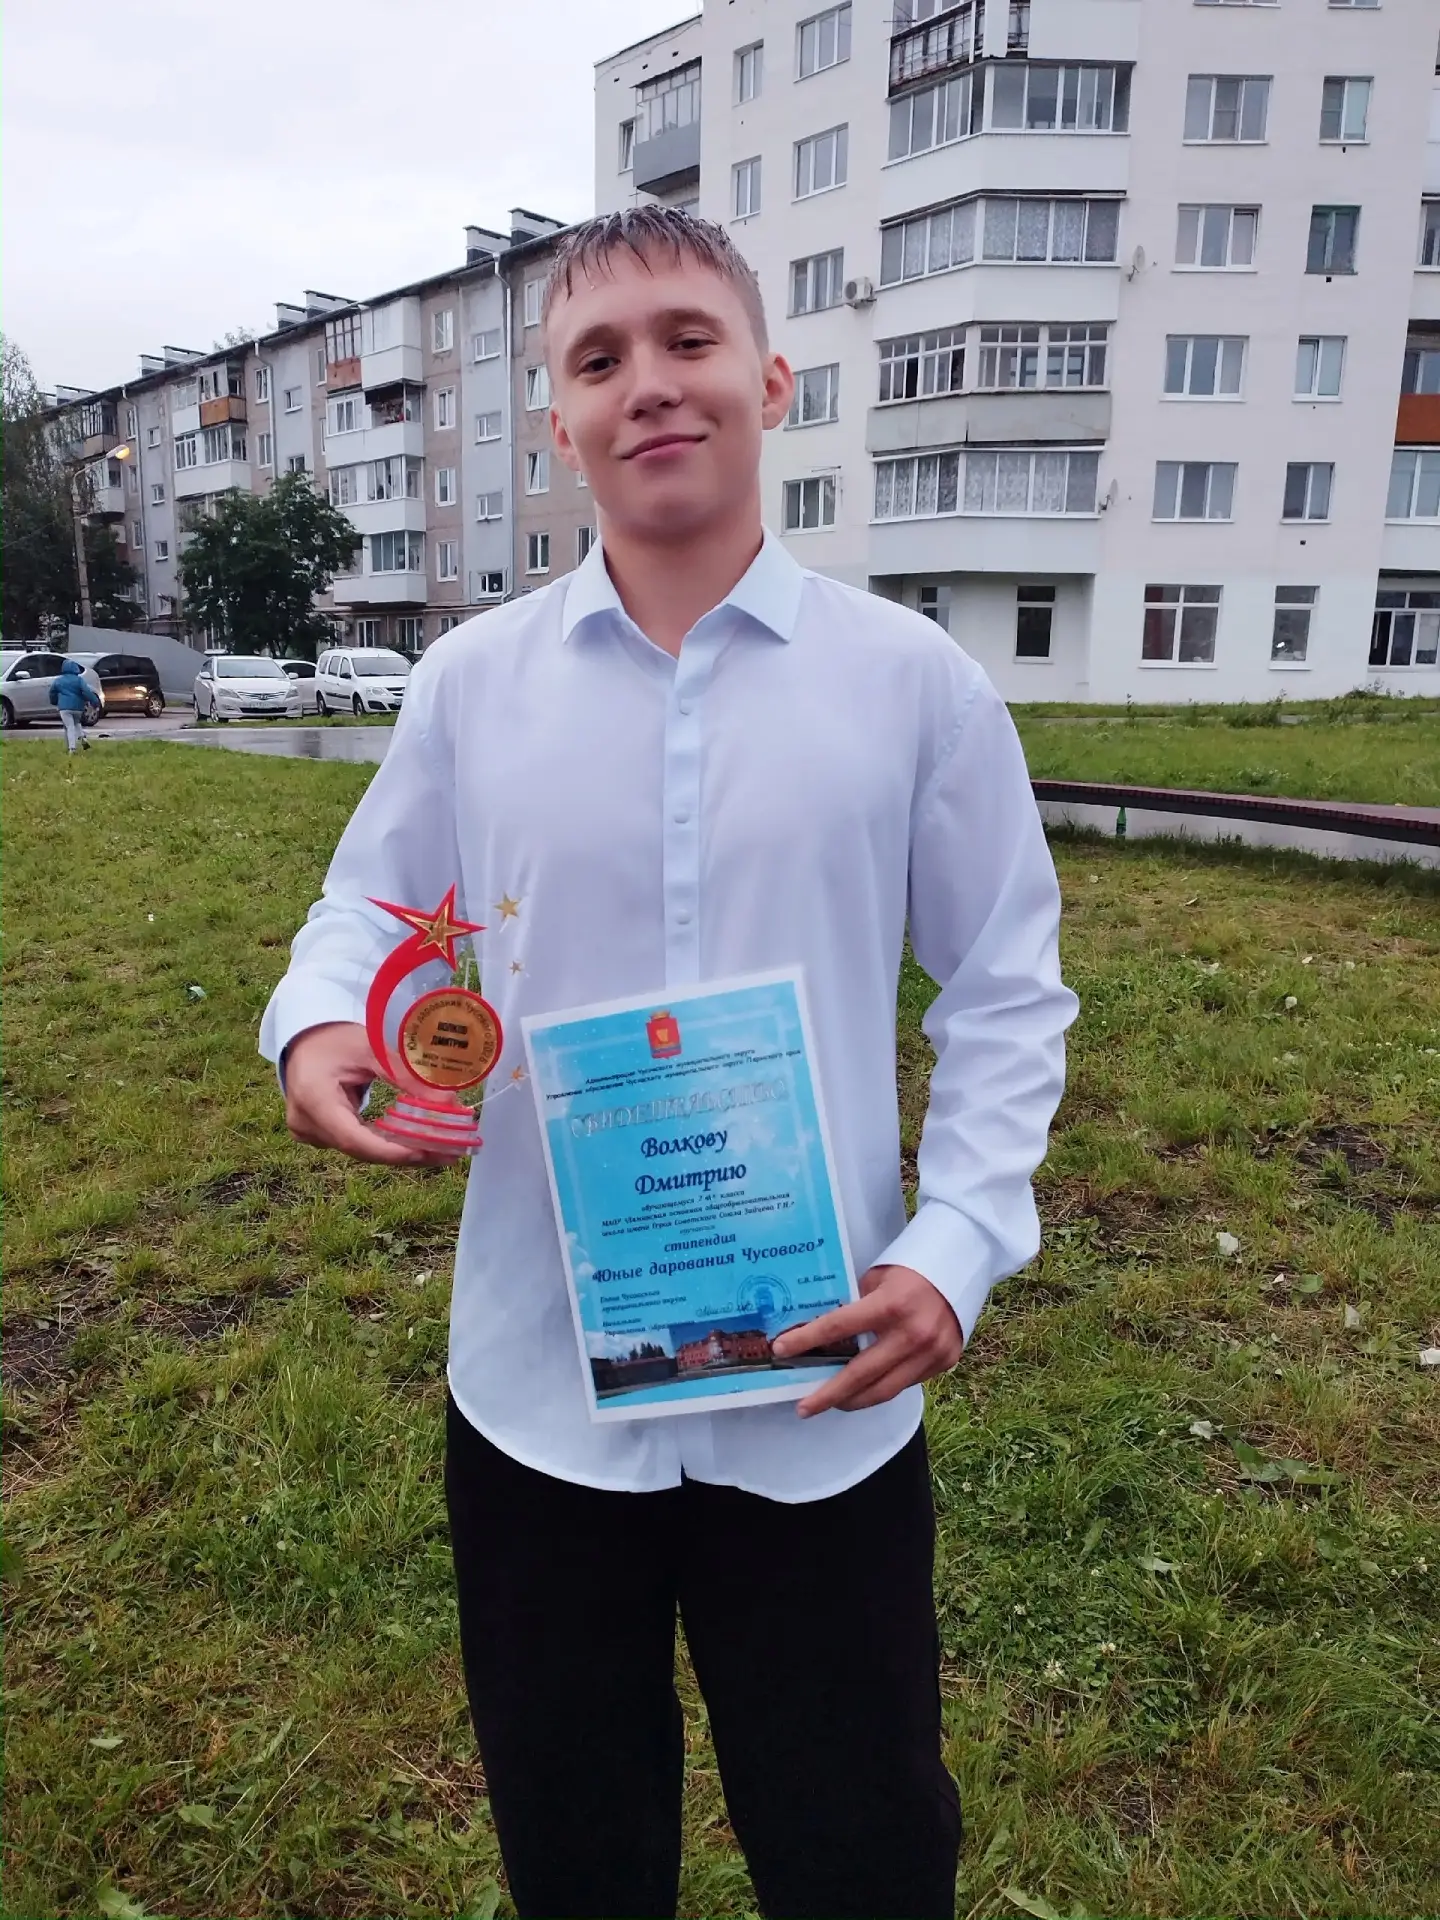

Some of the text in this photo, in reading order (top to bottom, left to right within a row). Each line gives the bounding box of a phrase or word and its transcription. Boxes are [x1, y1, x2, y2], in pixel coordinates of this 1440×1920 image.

[640, 1129, 728, 1159] Волкову
[634, 1162, 748, 1196] Дмитрию
[663, 1232, 737, 1254] стипендия
[591, 1237, 825, 1284] «Юные дарования Чусового»
